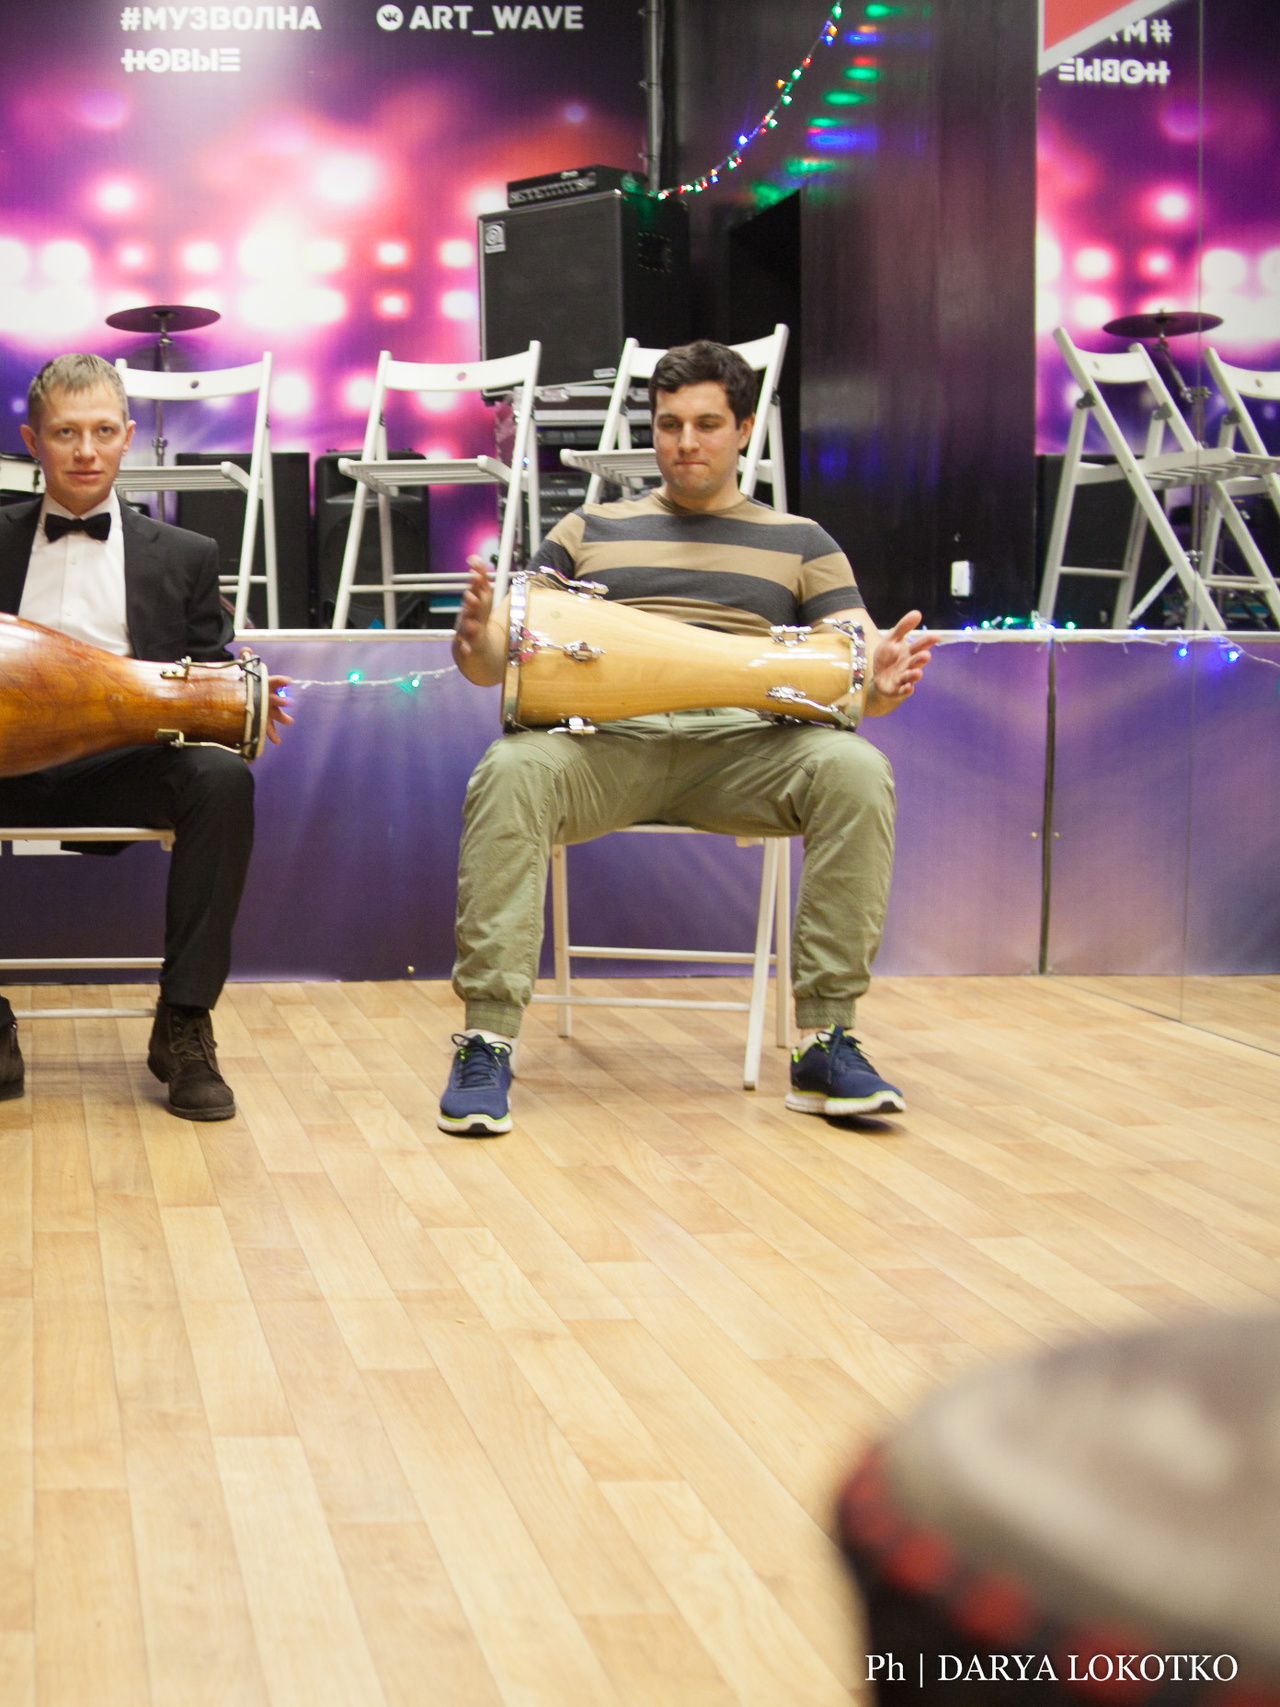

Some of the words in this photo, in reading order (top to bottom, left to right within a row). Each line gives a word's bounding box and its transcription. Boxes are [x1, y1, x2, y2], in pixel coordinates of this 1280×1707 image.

[120, 6, 322, 31] #МУЗВОЛНА
[409, 5, 584, 35] ART_WAVE
[121, 49, 240, 73] НОВЫЕ
